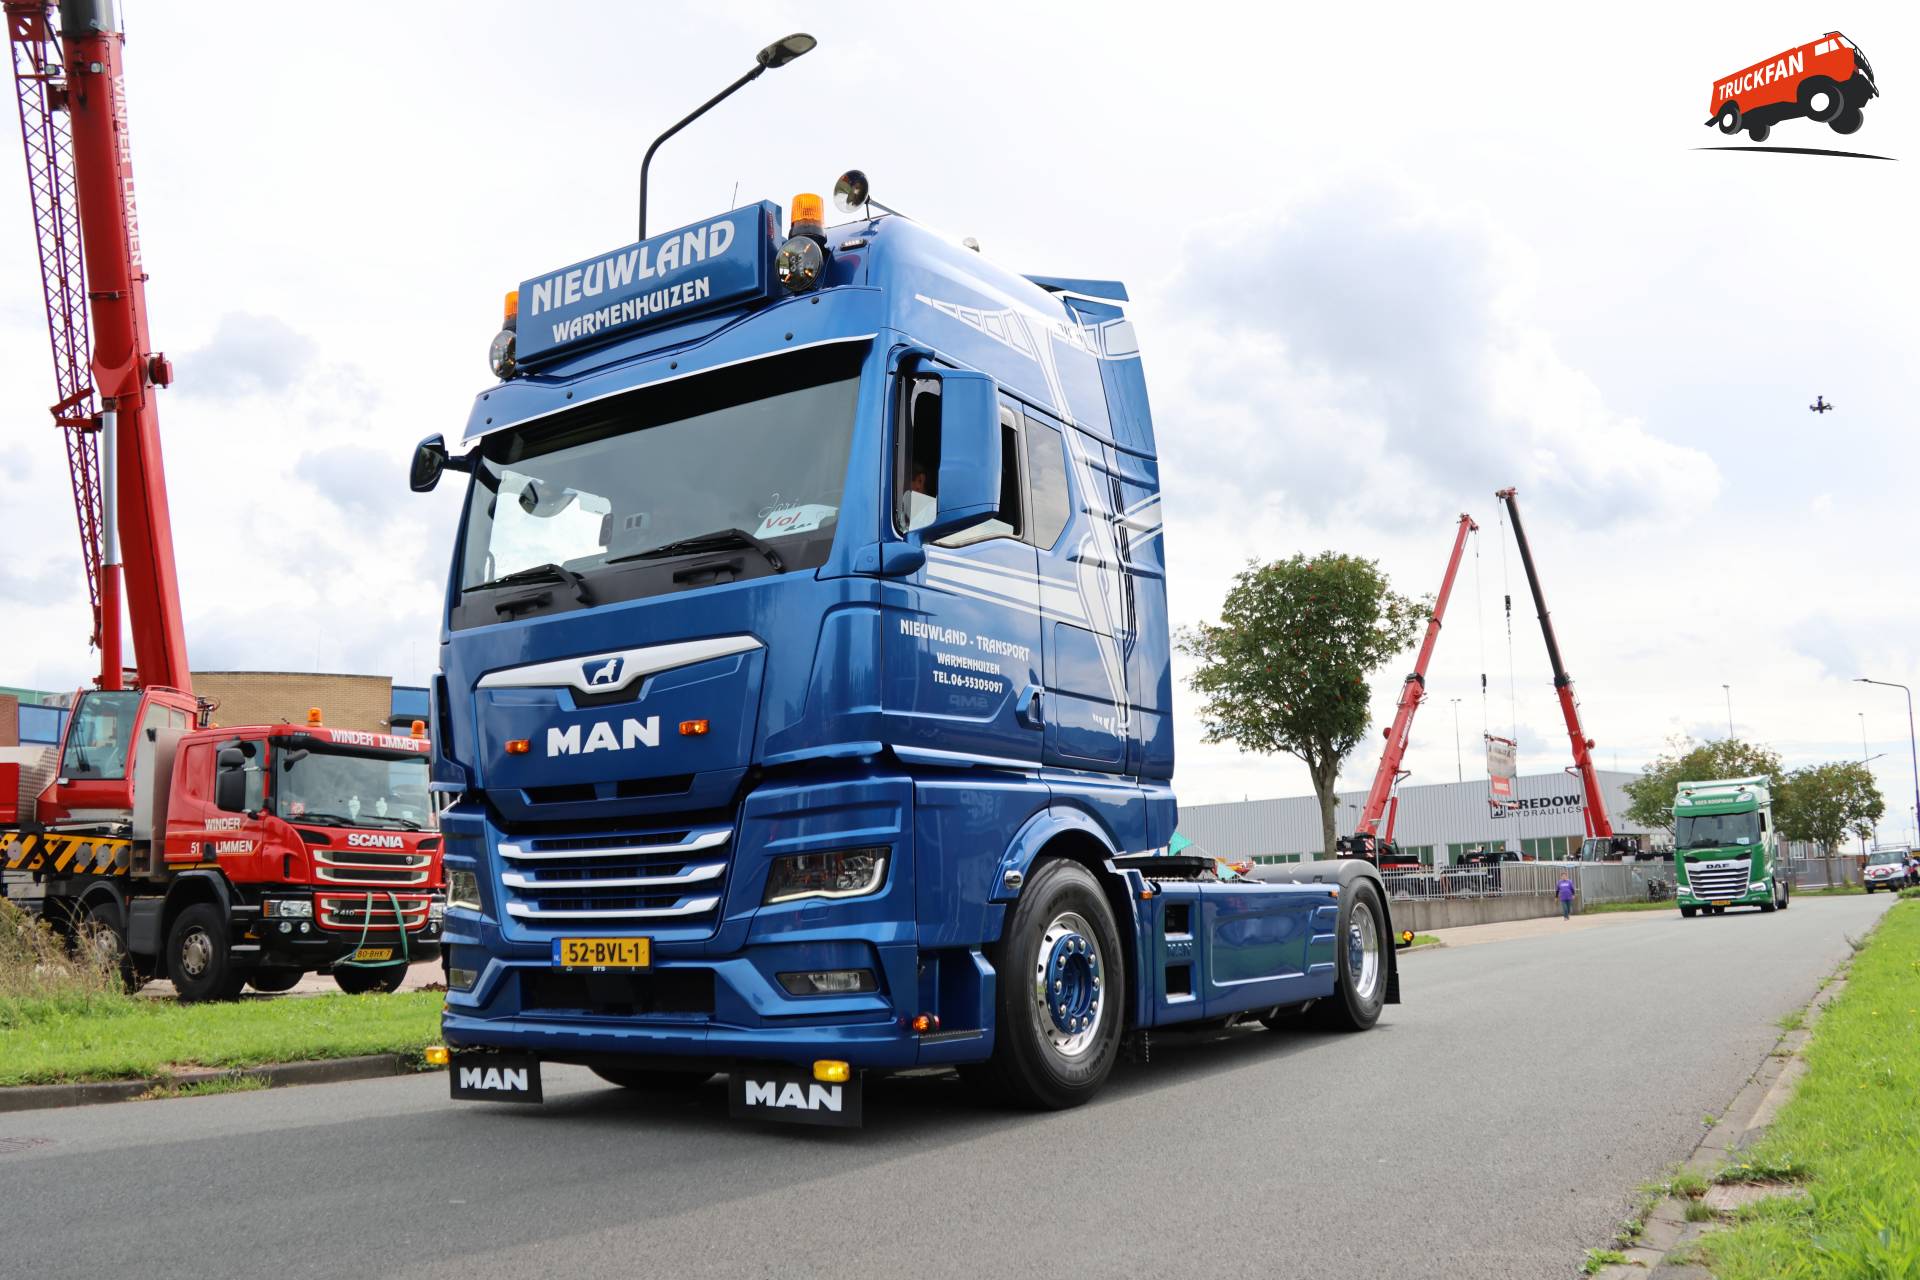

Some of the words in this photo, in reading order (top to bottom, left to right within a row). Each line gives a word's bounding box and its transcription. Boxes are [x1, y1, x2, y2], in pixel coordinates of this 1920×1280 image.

[113, 75, 132, 164] WINDER
[123, 177, 142, 267] LIMMEN
[531, 220, 735, 316] NIEUWLAND
[552, 276, 710, 343] WARMENHUIZEN
[900, 619, 967, 646] NIEUWLAND
[976, 635, 1030, 662] TRANSPORT
[936, 652, 1000, 675] WARMENHUIZEN
[933, 670, 1003, 694] TEL.06-55305097
[329, 729, 374, 746] WINDER
[379, 735, 419, 751] LIMMEN
[547, 715, 660, 757] MAN
[1507, 806, 1581, 818] HYDRAULICS
[205, 817, 241, 831] WINDER
[190, 842, 200, 854] 51
[215, 840, 253, 853] LIMMEN
[347, 833, 404, 848] SCANIA
[569, 942, 639, 962] 52-BVL-1
[460, 1067, 528, 1091] MAN
[745, 1080, 842, 1112] MAN
